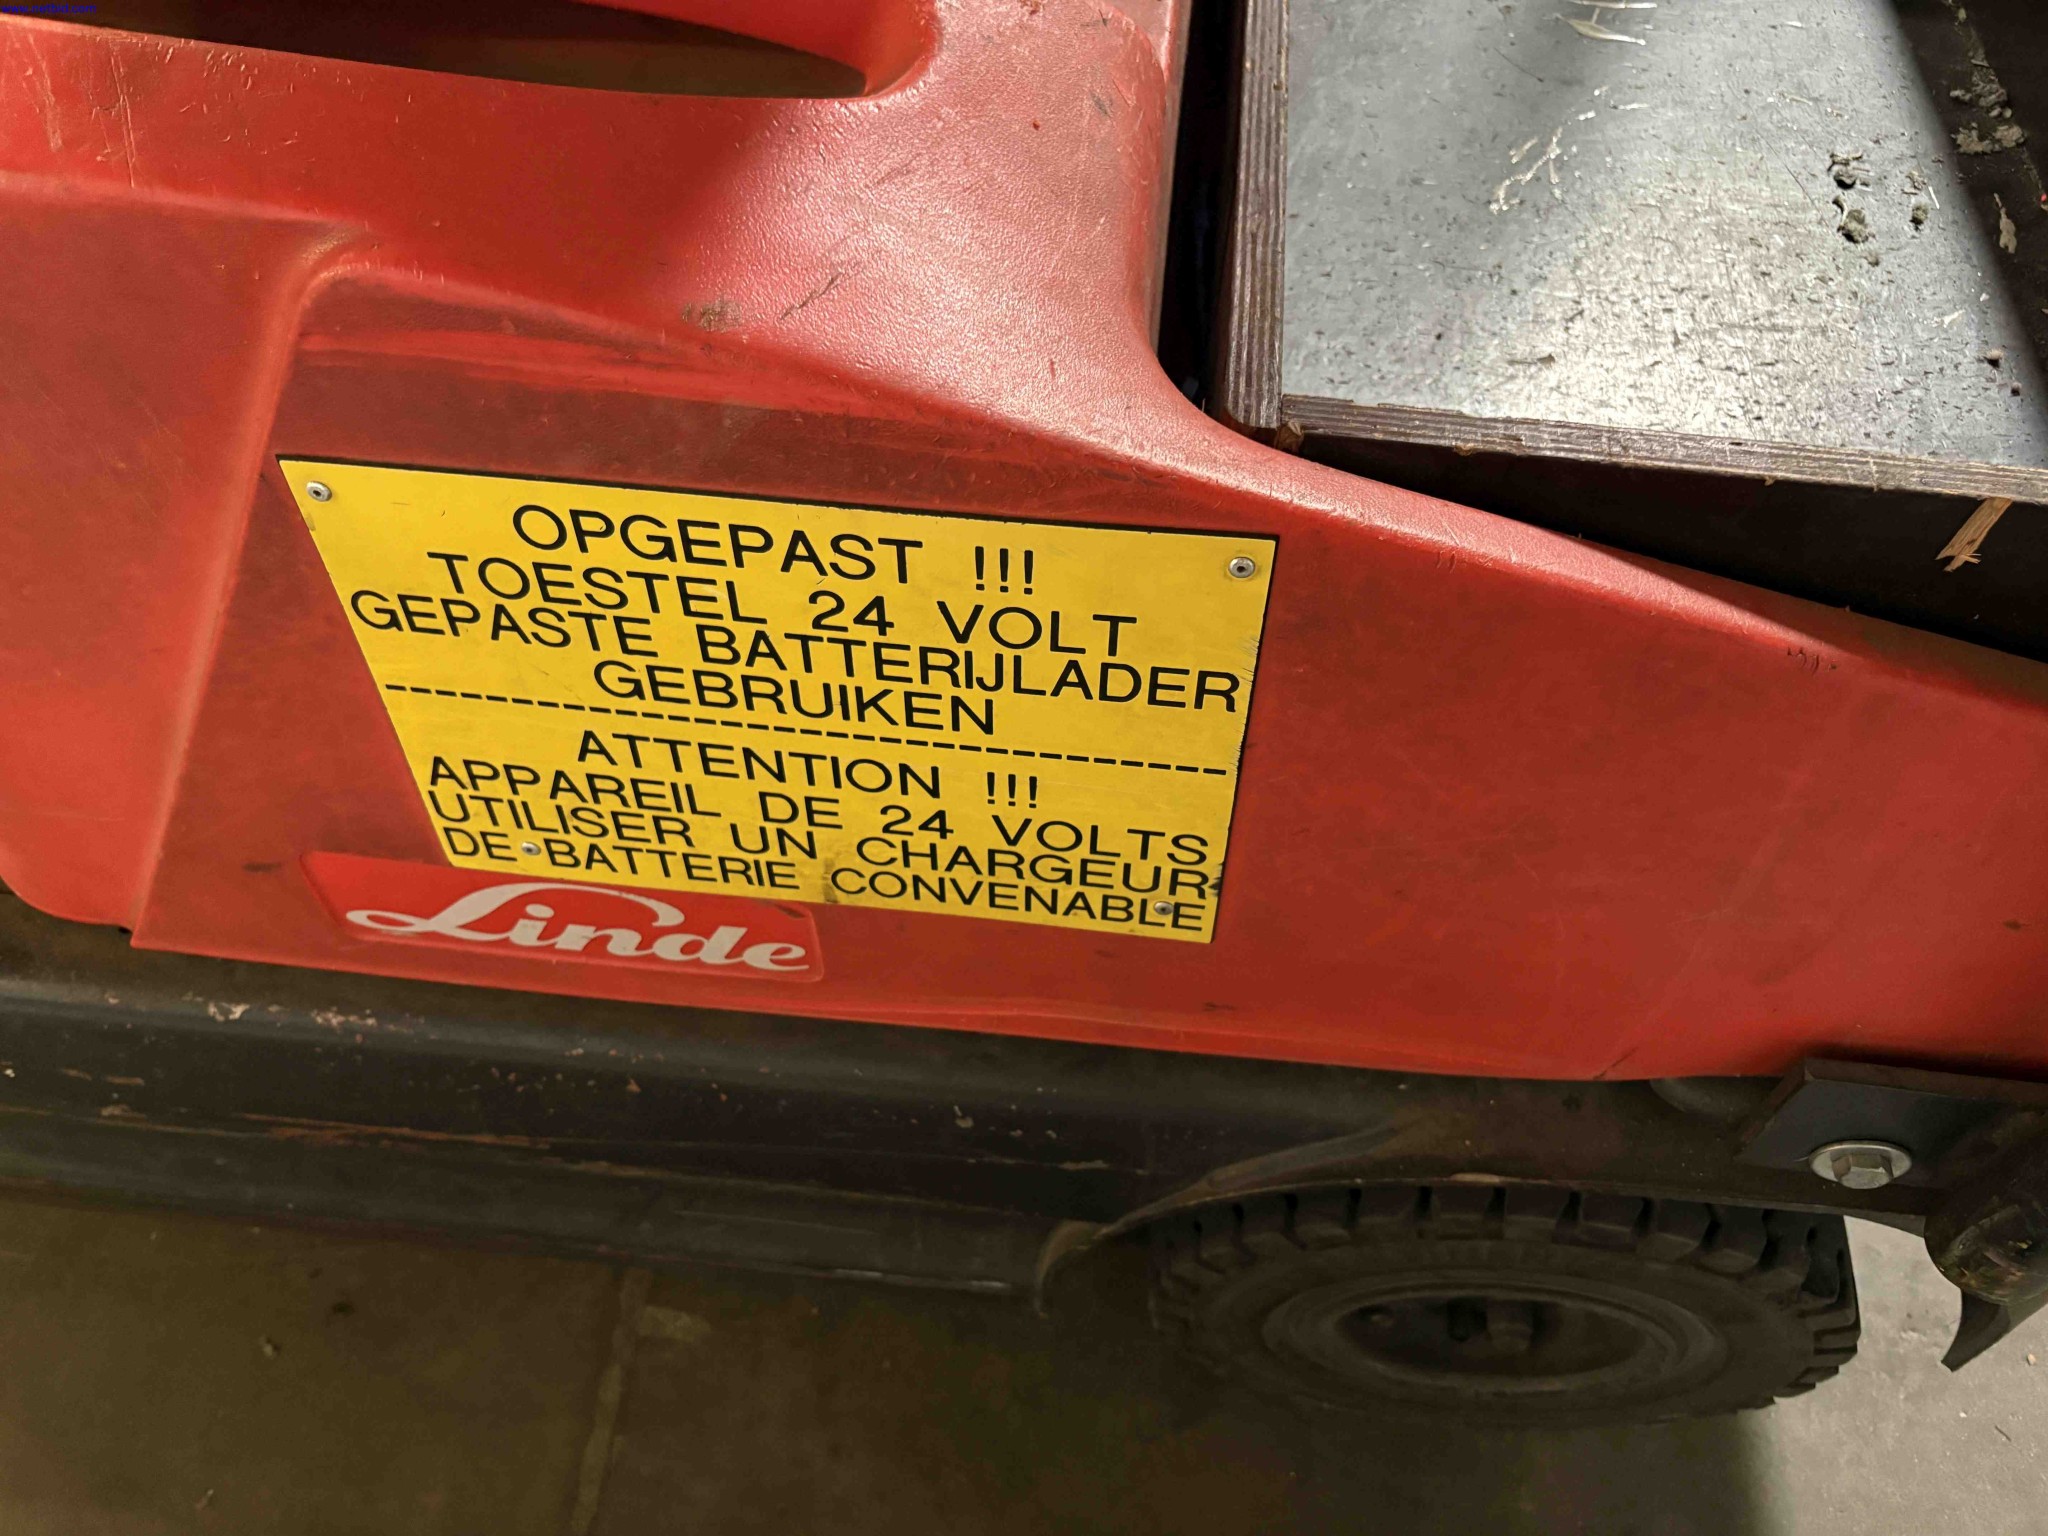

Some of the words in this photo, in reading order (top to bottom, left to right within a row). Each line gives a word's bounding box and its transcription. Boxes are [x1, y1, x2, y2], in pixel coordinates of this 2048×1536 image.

[513, 504, 923, 584] OPGEPAST
[974, 545, 1035, 595] !!!
[350, 590, 659, 658] GEPASTE
[696, 624, 1241, 713] BATTERIJLADER
[427, 552, 768, 624] TOESTEL
[808, 590, 895, 637] 24
[937, 600, 1137, 658] VOLT
[594, 660, 994, 735] GEBRUIKEN
[430, 756, 722, 818] APPAREIL
[760, 791, 843, 830] DE
[880, 805, 954, 840] 24
[992, 815, 1209, 866] VOLTS
[577, 730, 941, 799] ATTENTION
[986, 772, 1039, 809] !!!
[428, 790, 696, 849] UTILISER
[730, 823, 818, 860] UN
[856, 837, 1209, 899] CHARGEUR
[443, 827, 518, 862] DE
[544, 839, 801, 890] BATTERIE
[830, 867, 1206, 931] CONVENABLE
[345, 882, 811, 971] Linde
